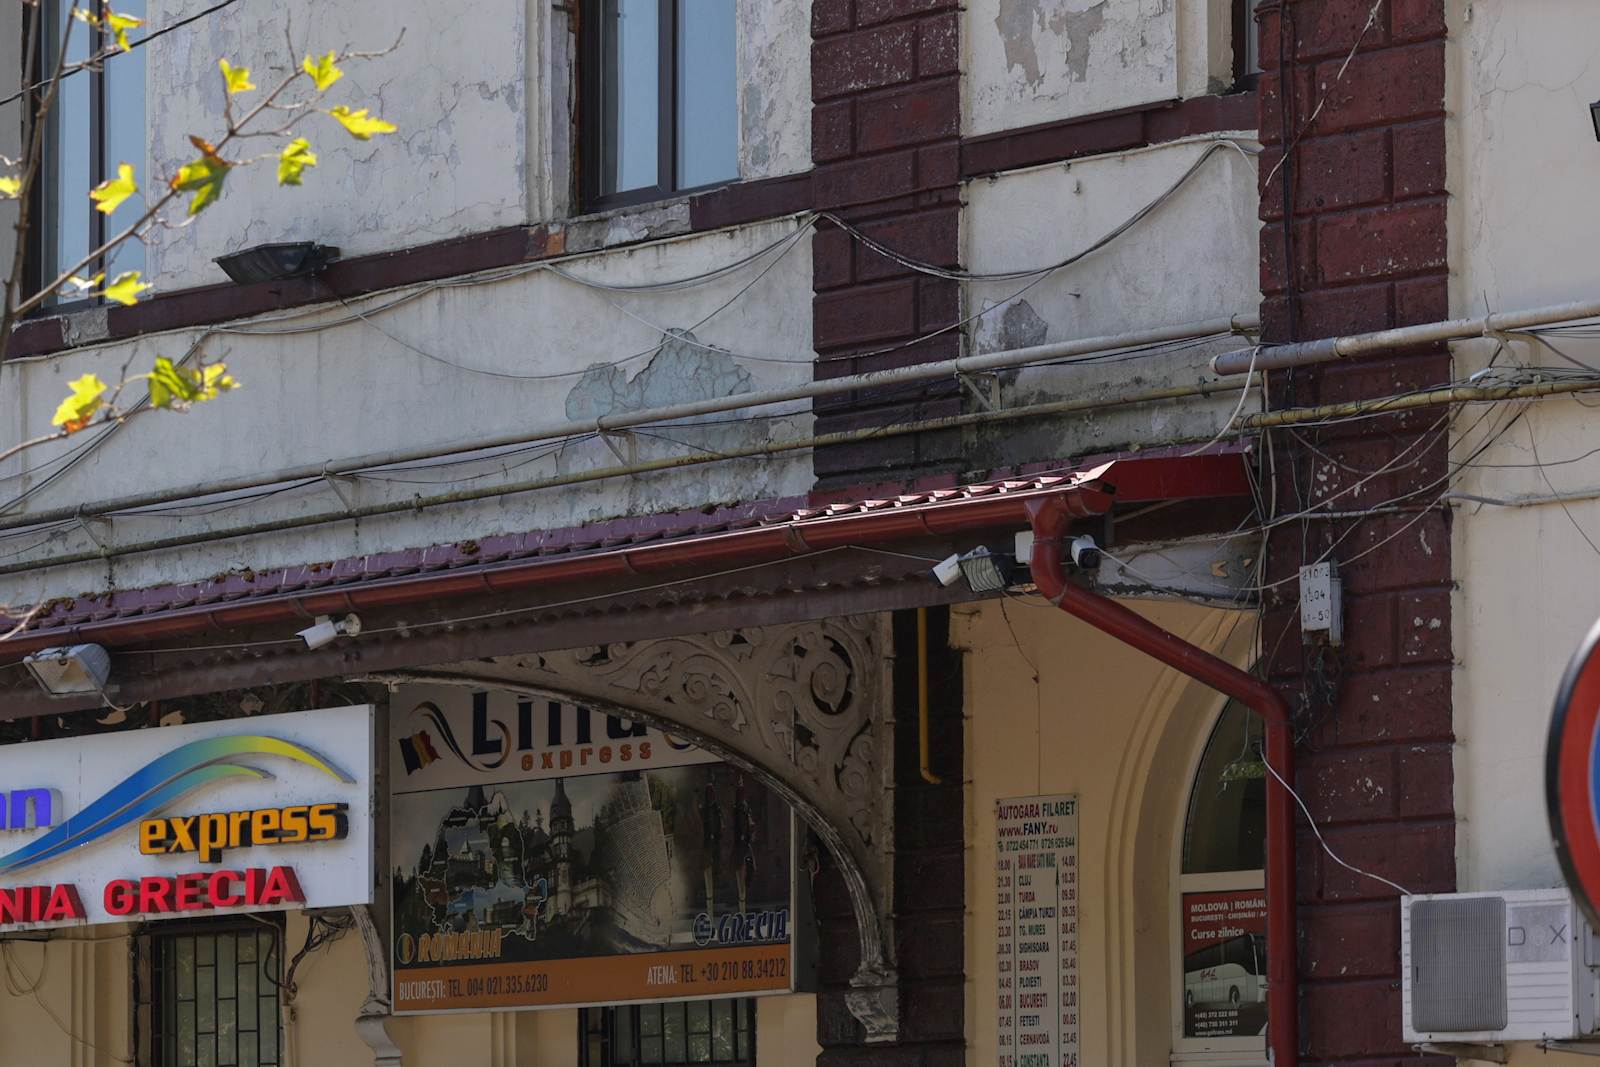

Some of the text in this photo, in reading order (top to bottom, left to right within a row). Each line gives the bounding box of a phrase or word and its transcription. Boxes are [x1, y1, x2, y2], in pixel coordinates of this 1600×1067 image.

[520, 741, 652, 771] express
[997, 801, 1076, 820] AUTOGARA FILARET
[139, 802, 349, 864] express
[1019, 875, 1032, 886] CLUJ
[103, 866, 308, 917] GRECIA
[1018, 891, 1036, 903] TURDA
[1190, 902, 1229, 913] MOLDOVA
[718, 909, 788, 945] GRECIA
[1191, 926, 1245, 940] Curse zilnice
[417, 928, 502, 963] ROMANIA
[1019, 941, 1050, 954] SIGHISOARA
[646, 965, 678, 985] ATENA:
[680, 964, 698, 983] TEL.
[700, 962, 719, 981] +30
[721, 960, 739, 979] 210
[1019, 959, 1040, 971] BRASOV
[448, 979, 465, 998] TEL.
[467, 978, 484, 996] 004
[1019, 976, 1042, 988] PLOIESTI
[1019, 993, 1048, 1009] BUCURESTI
[1019, 1015, 1040, 1027] FETESTI
